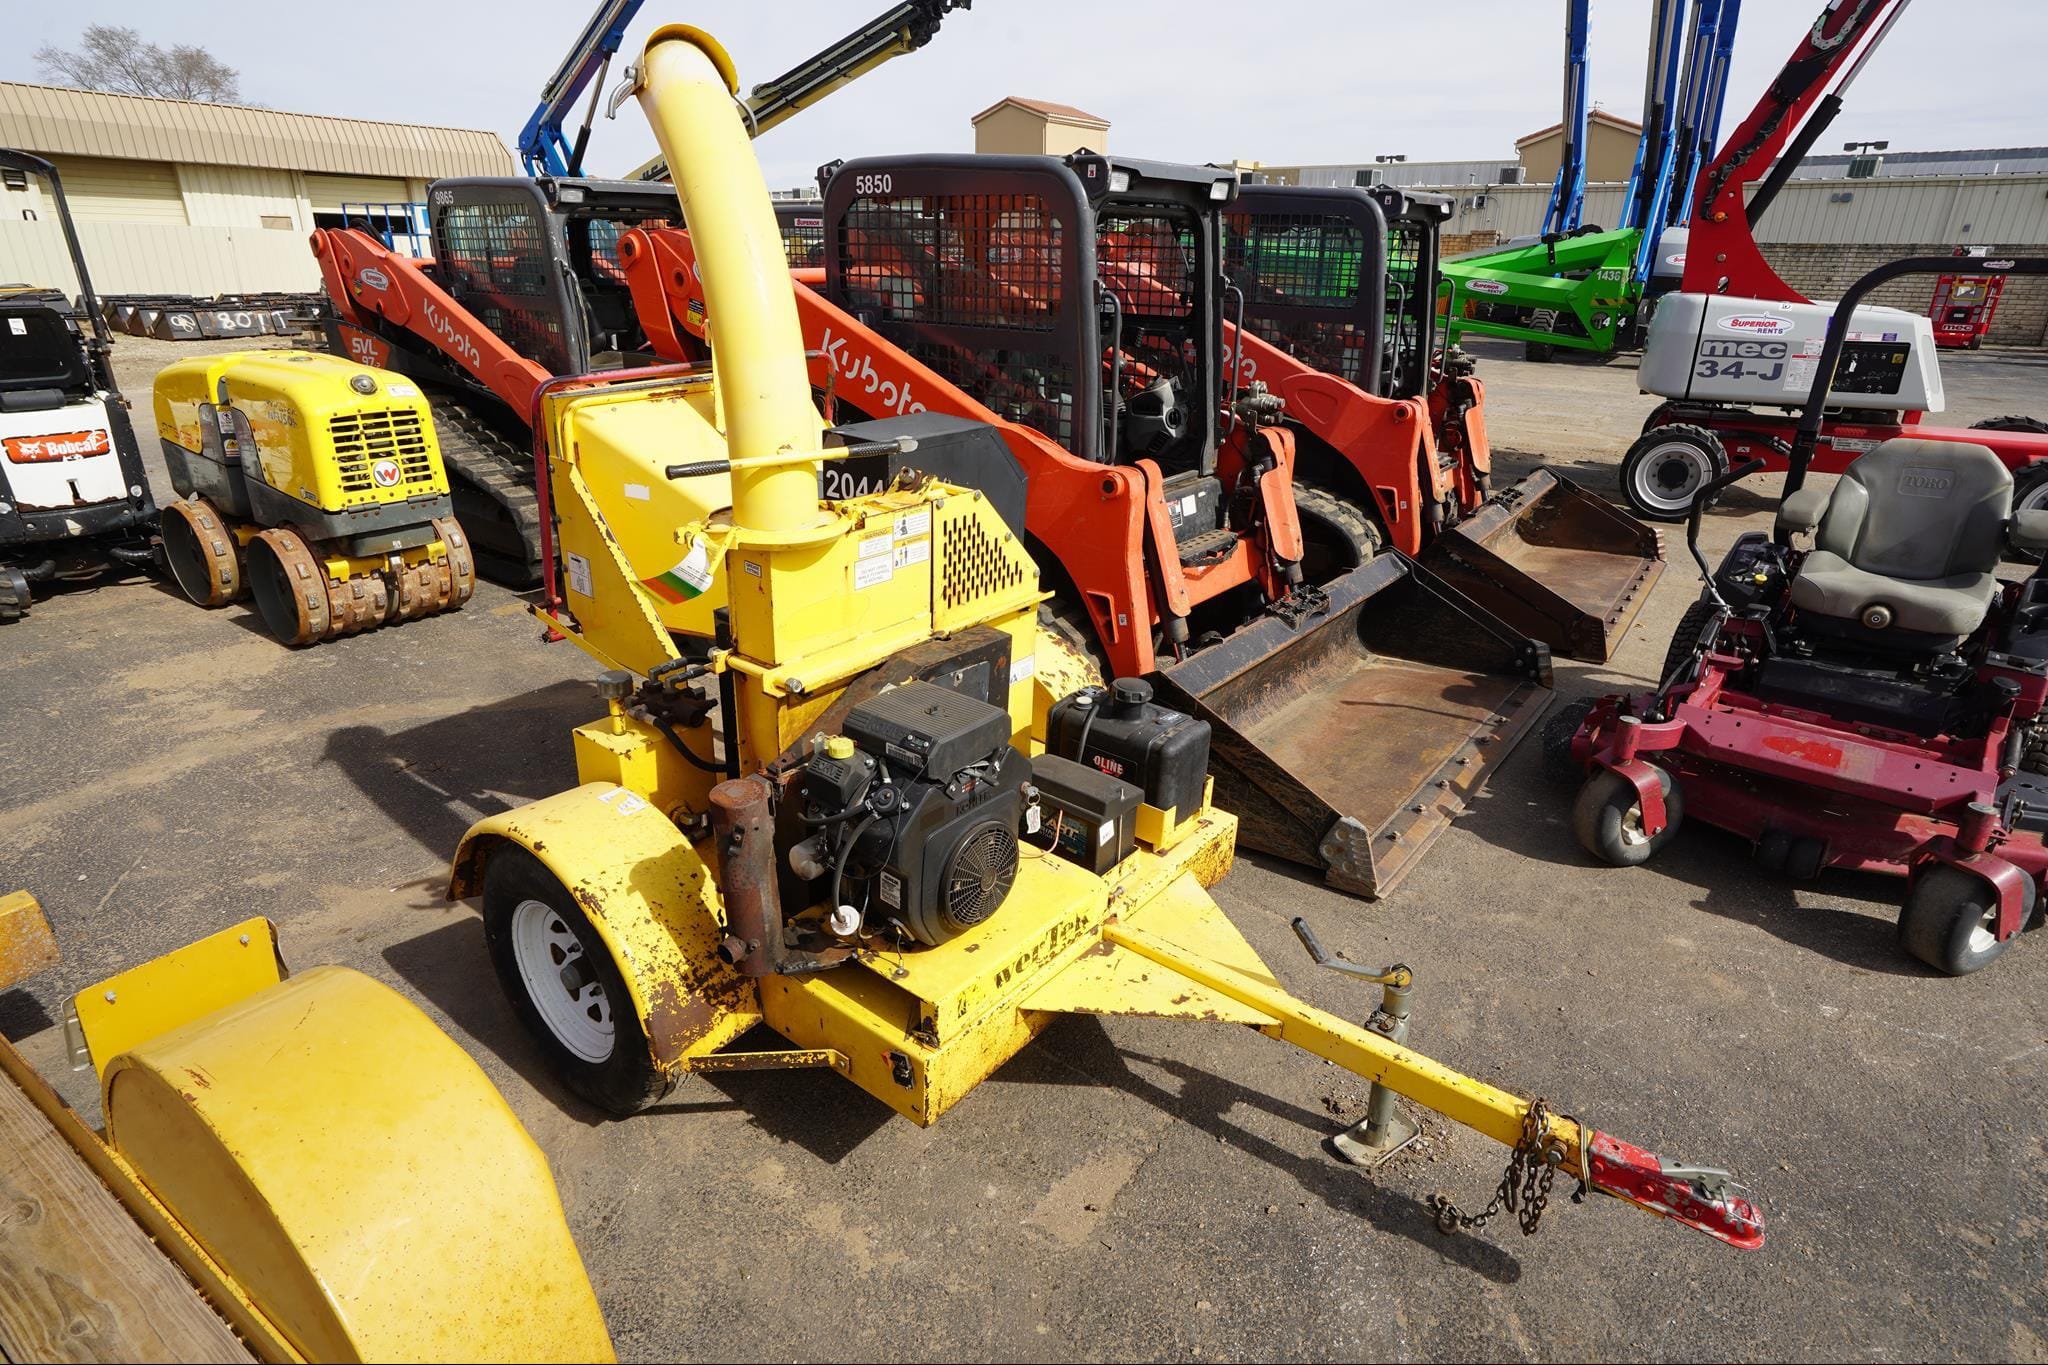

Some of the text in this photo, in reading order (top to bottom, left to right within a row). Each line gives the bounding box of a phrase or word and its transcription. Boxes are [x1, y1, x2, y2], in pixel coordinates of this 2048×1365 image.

[855, 174, 893, 195] 5850
[434, 190, 454, 205] 9865
[1596, 270, 1622, 281] 1436
[1730, 318, 1778, 329] SUPERIOR
[423, 298, 480, 369] Kubota
[351, 338, 378, 356] SVL
[1701, 341, 1787, 359] mec
[1696, 359, 1784, 381] 34-J
